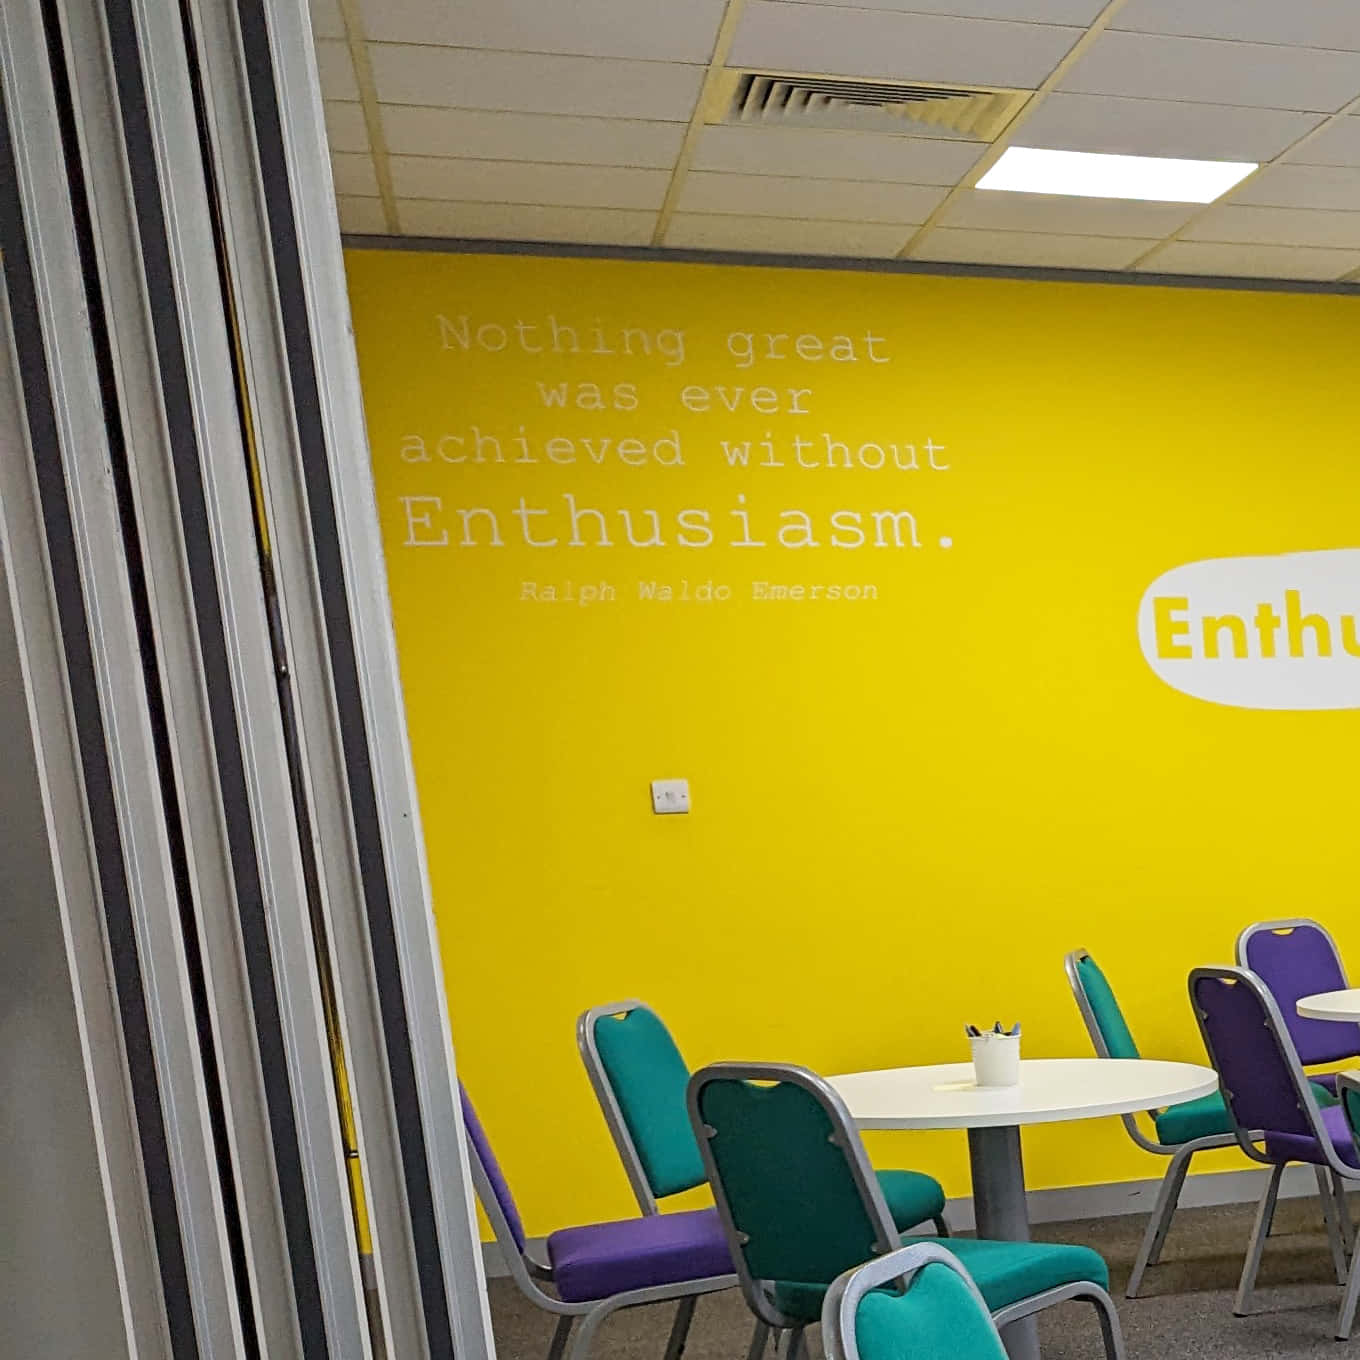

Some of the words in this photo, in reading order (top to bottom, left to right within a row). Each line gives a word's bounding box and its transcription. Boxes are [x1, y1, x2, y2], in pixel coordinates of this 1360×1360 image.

[436, 314, 686, 366] Nothing
[727, 328, 891, 368] great
[537, 380, 639, 410] was
[681, 384, 813, 414] ever
[400, 426, 685, 467] achieved
[721, 434, 951, 472] without
[399, 494, 953, 549] Enthusiasm.
[520, 580, 616, 605] Ralph
[638, 580, 732, 602] Waldo
[752, 581, 879, 601] Emerson
